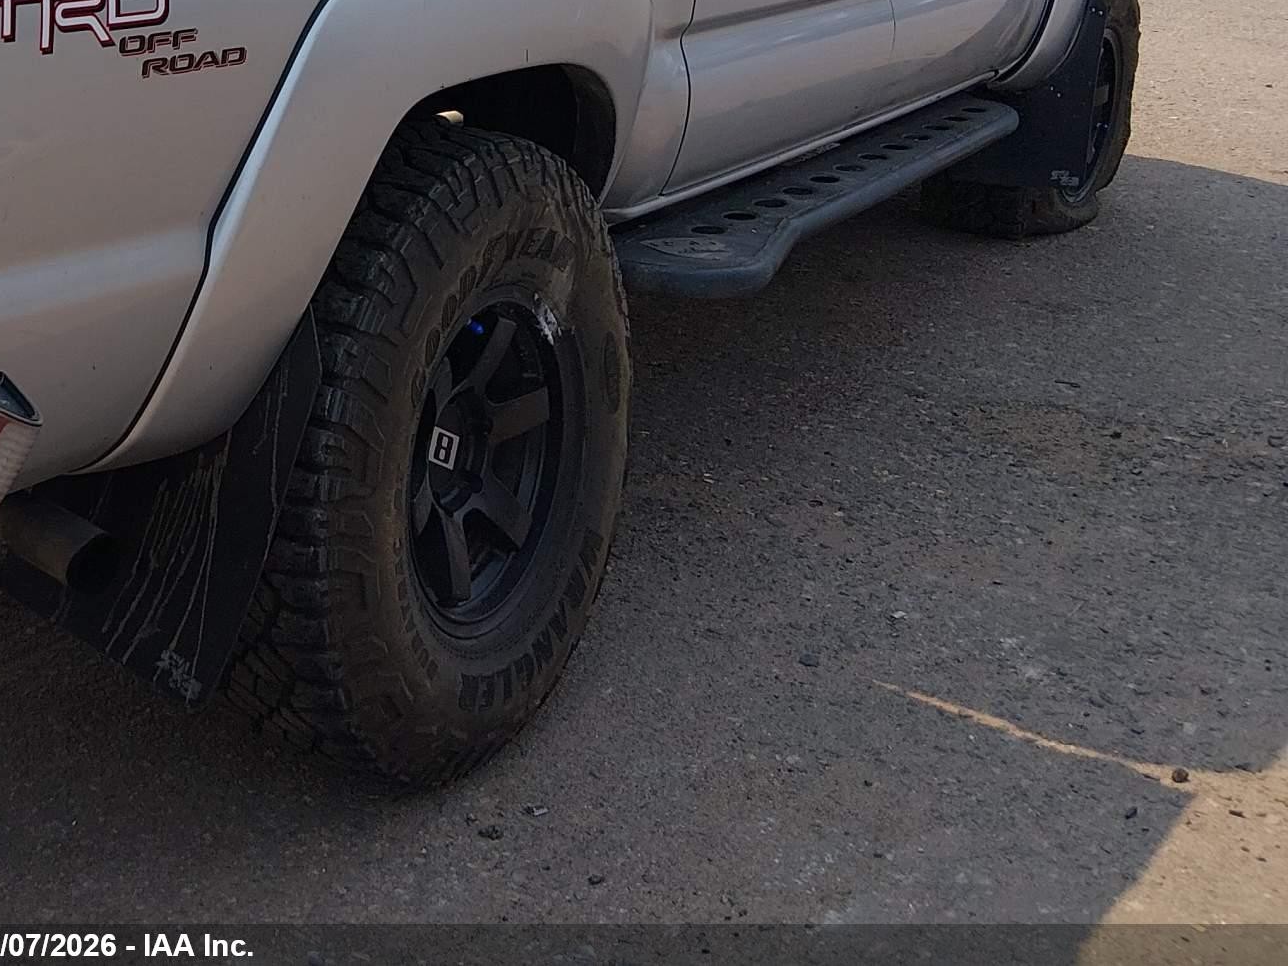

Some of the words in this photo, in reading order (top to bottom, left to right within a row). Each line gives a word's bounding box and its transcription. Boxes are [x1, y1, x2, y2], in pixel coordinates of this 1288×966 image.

[118, 28, 198, 56] OFF
[141, 46, 247, 79] ROAD
[410, 226, 577, 407] GOODYEAR
[457, 528, 604, 714] WRANGLER
